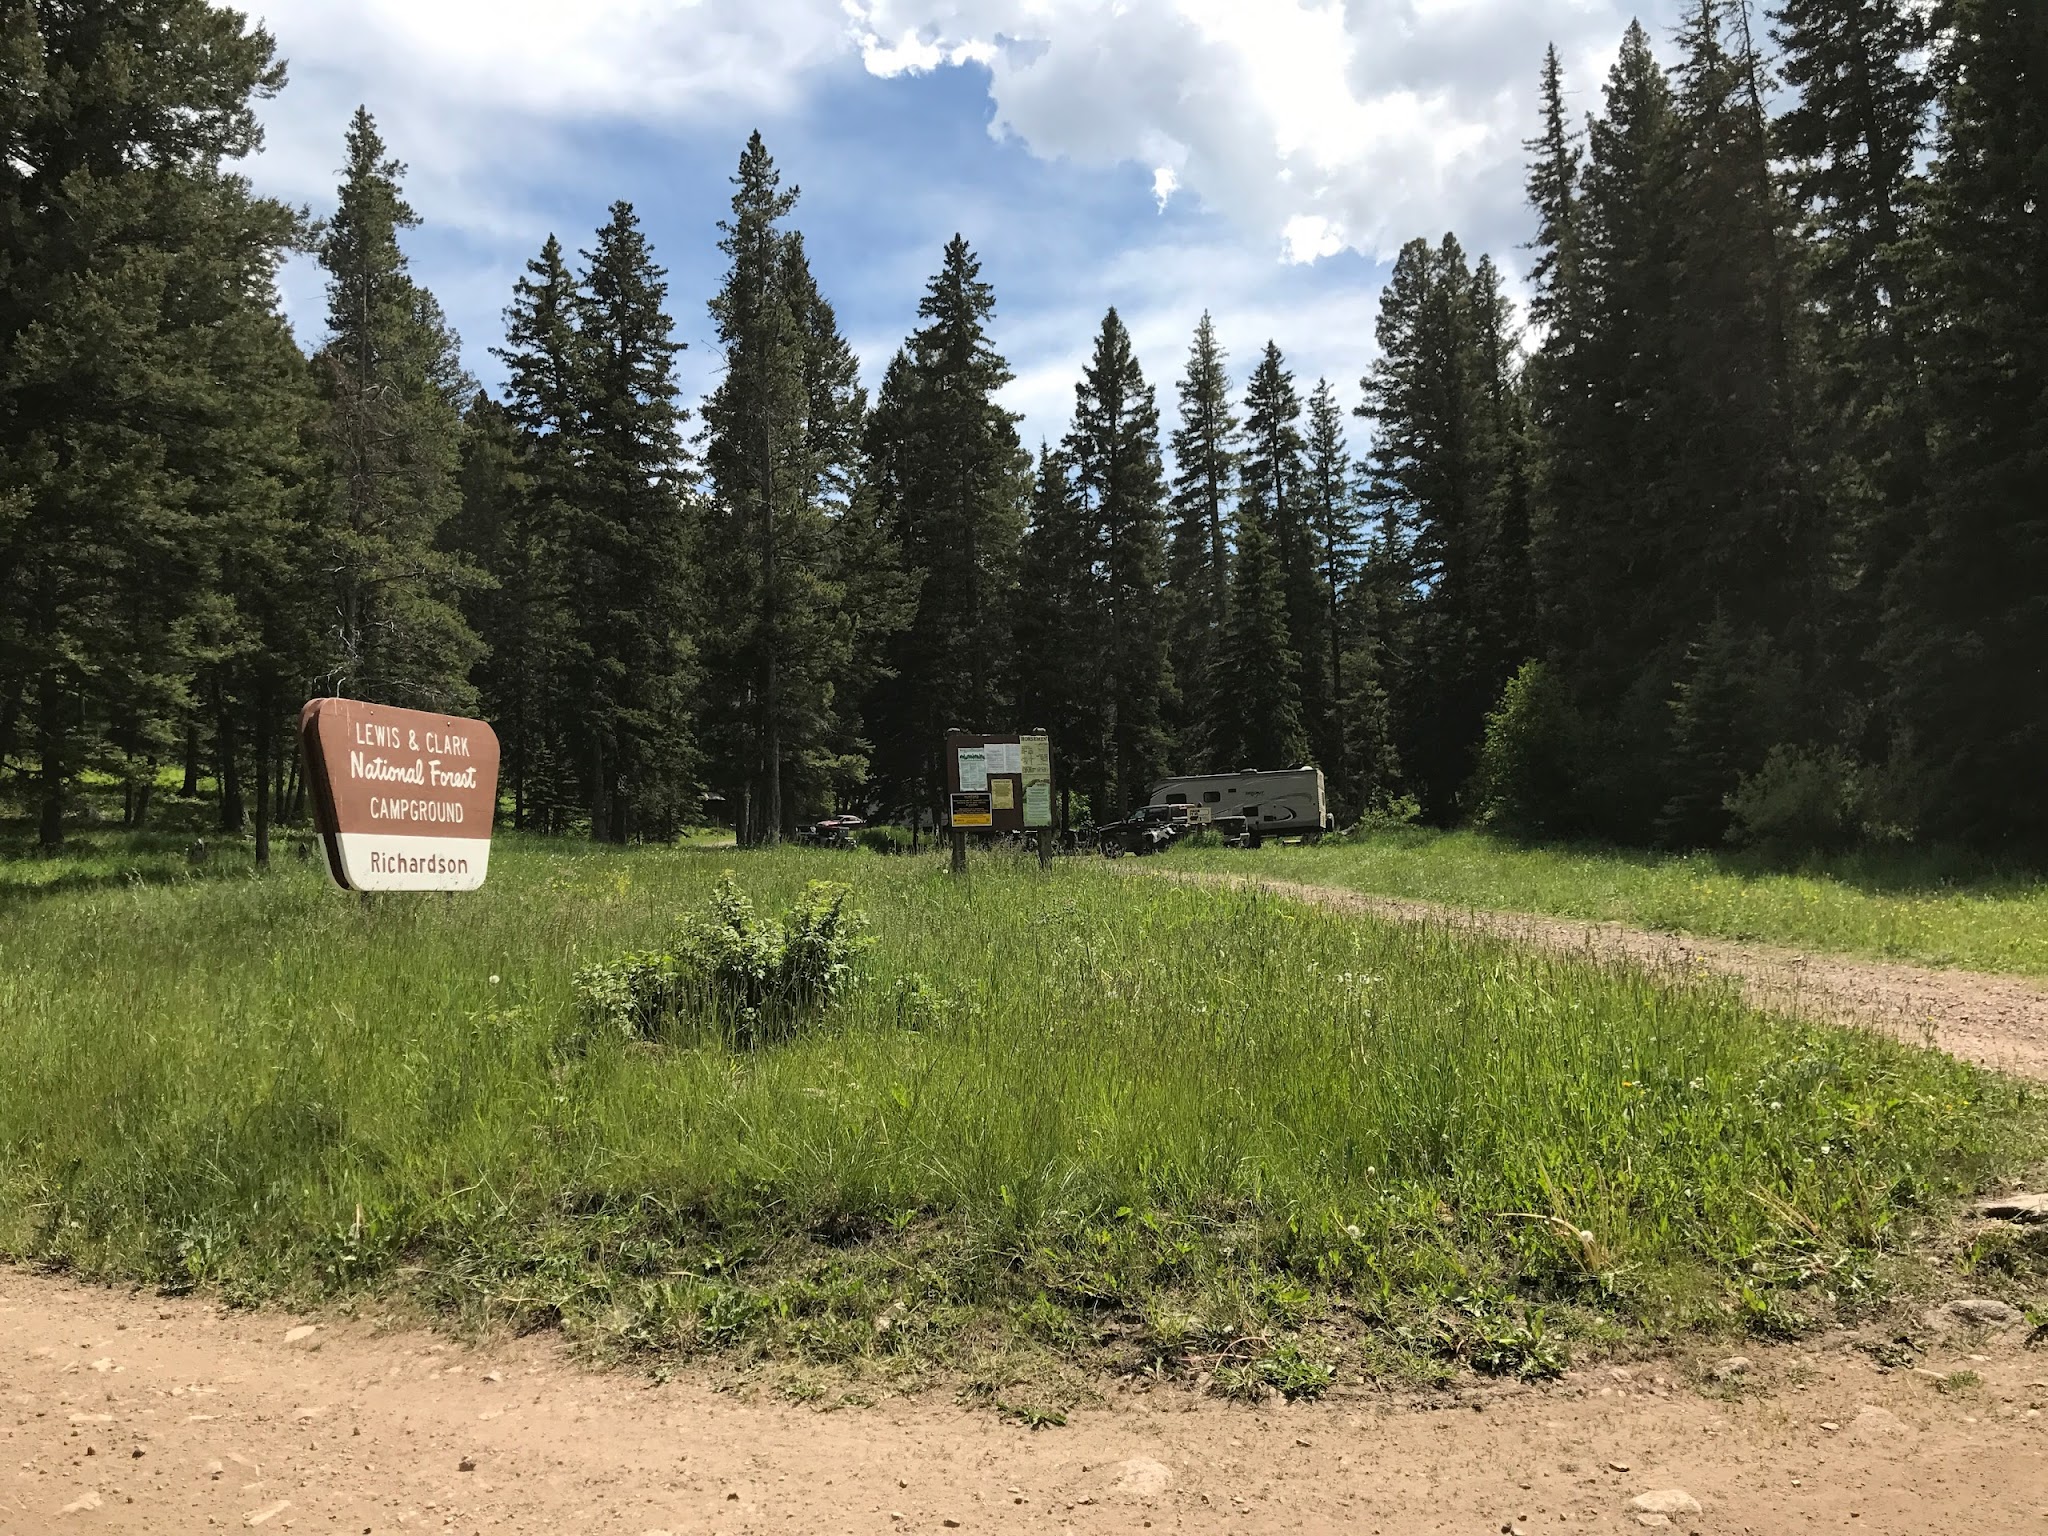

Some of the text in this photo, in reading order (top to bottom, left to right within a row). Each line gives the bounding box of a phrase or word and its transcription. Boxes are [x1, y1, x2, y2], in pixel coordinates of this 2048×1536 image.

[356, 722, 470, 757] LEWIS & CLARK
[350, 750, 477, 789] National Forest
[370, 797, 464, 823] CAMPGROUND
[371, 851, 468, 874] Richardson
